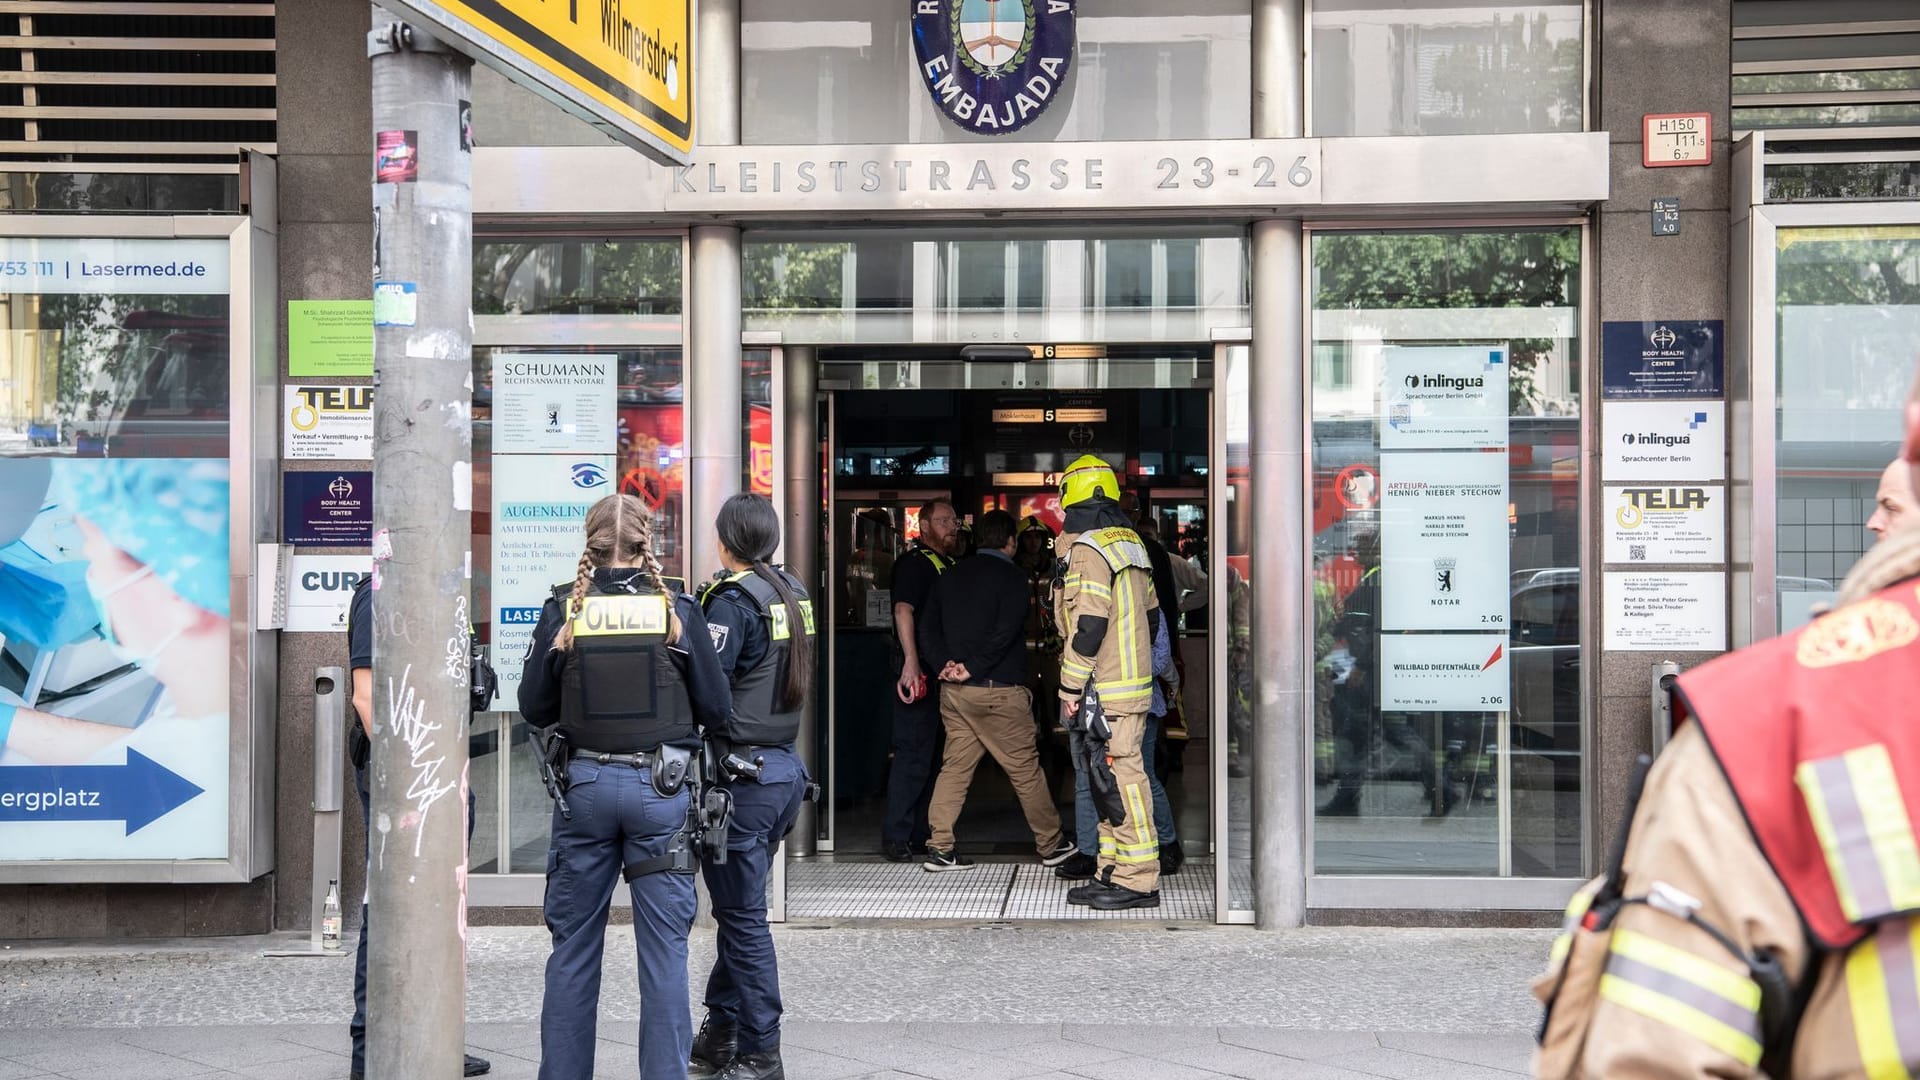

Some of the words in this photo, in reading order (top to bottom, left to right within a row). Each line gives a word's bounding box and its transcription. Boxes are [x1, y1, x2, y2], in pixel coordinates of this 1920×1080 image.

[600, 0, 679, 88] Wilmersdof
[923, 54, 1065, 129] EMBAJADA
[1658, 119, 1695, 132] H150
[672, 157, 1105, 194] KLEISTSTRASSE
[1653, 201, 1664, 210] AS
[81, 261, 206, 277] Lasermed.de
[1044, 346, 1055, 358] 6
[504, 363, 606, 376] SCHUMANN
[1423, 373, 1484, 391] inlingua
[1044, 410, 1055, 422] 5
[292, 433, 317, 441] Verkauf
[322, 433, 359, 442] Vermittlung
[1638, 433, 1691, 447] inlingua
[1621, 455, 1668, 463] Sprachcenter
[1044, 474, 1055, 486] 4
[1388, 482, 1428, 490] ARTEJURA
[1387, 489, 1420, 497] HENNIG
[1425, 489, 1456, 497] NIEBER
[1460, 488, 1502, 497] STECHOW
[1621, 488, 1711, 509] TELA
[504, 505, 588, 519] AUGENKLINI
[514, 525, 586, 534] WITTENBERGPL
[1046, 537, 1054, 549] 3
[504, 609, 541, 622] LASE
[575, 599, 663, 632] OLIZEI
[1481, 615, 1489, 623] 2.
[1490, 615, 1503, 623] OG
[1393, 663, 1430, 671] WILLIBALD
[1431, 662, 1481, 671] DIEFENTHÄLER
[1480, 696, 1489, 704] 2.
[1490, 696, 1503, 704] OG
[0, 787, 101, 812] ergplatz
